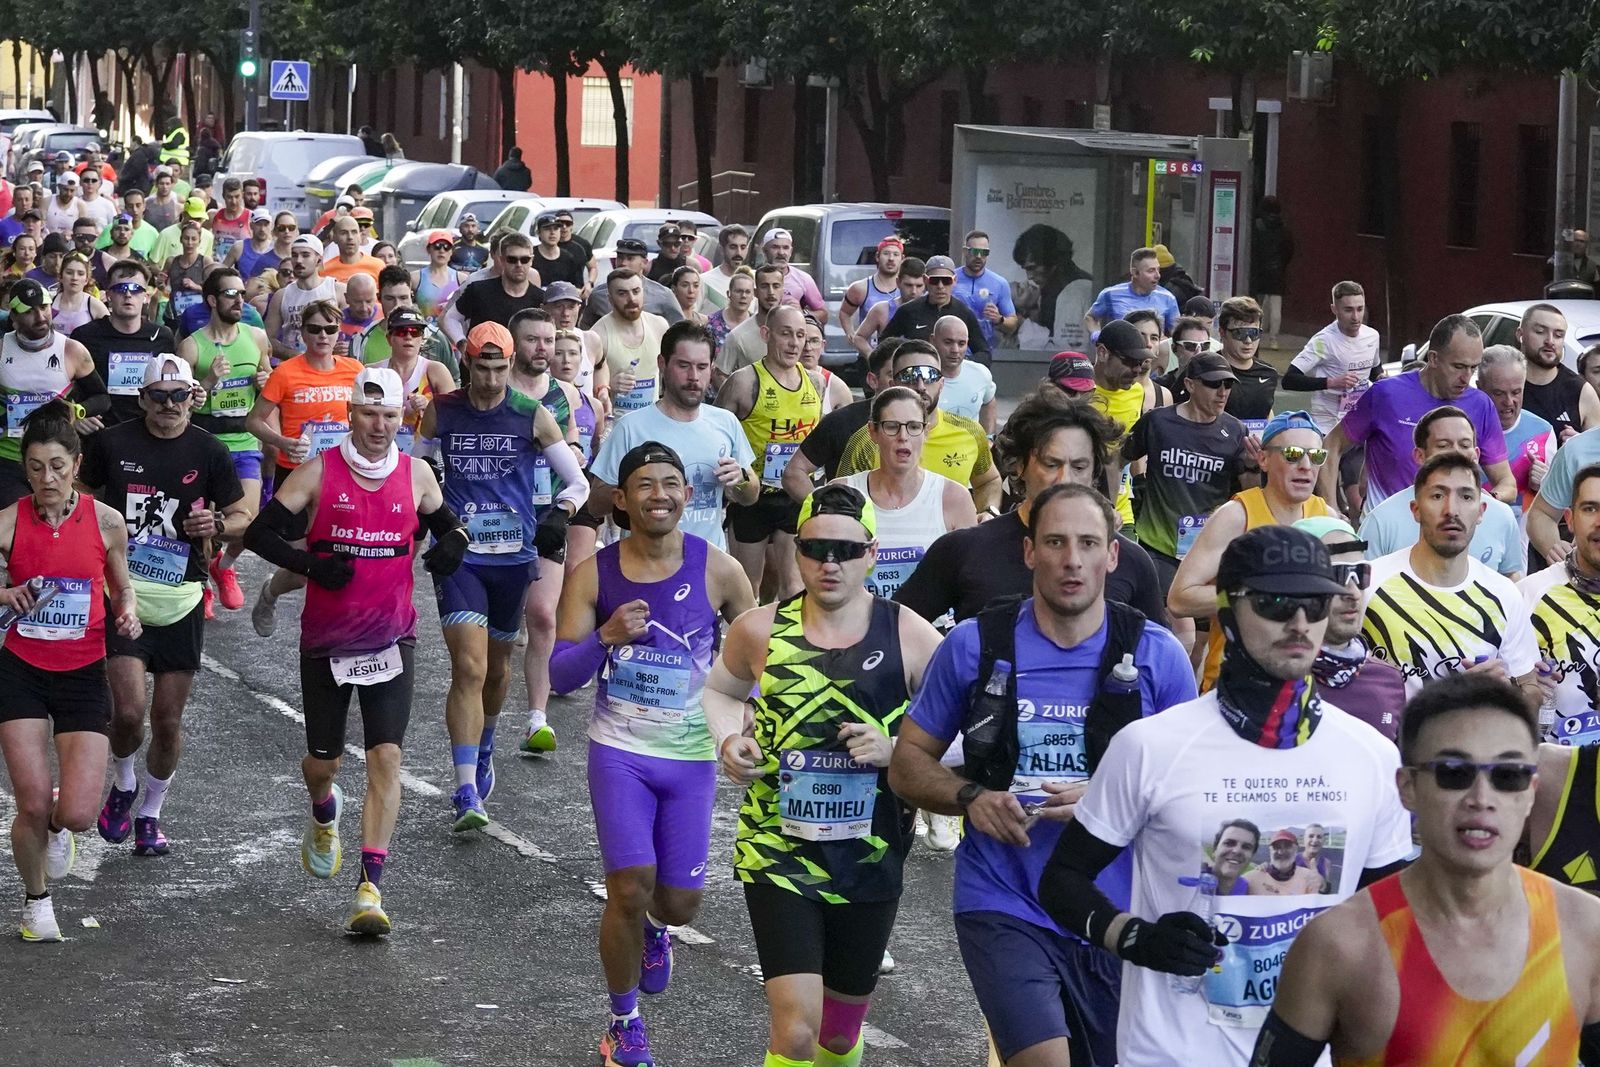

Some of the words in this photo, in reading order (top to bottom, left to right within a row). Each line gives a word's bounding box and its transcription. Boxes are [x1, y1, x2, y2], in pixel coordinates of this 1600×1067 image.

[1155, 163, 1167, 172] C2
[1170, 163, 1177, 172] 5
[1182, 163, 1188, 172] 6
[1191, 163, 1202, 172] 43
[121, 376, 143, 385] JACK
[225, 379, 248, 388] ZURICH
[319, 424, 345, 432] ZURICH
[127, 483, 156, 495] SEVILLA
[151, 538, 183, 553] ZURICH
[350, 546, 359, 555] DE
[876, 550, 916, 561] ZURICH
[877, 570, 900, 580] 6633
[637, 650, 682, 666] ZURICH
[346, 661, 389, 677] JESULI
[635, 671, 660, 685] 9688
[616, 678, 634, 689] SETIA
[635, 683, 655, 694] ASICS
[656, 687, 679, 697] FRON-
[629, 693, 661, 706] TRUNNER
[1044, 733, 1076, 746] 6855
[1029, 752, 1088, 773] ALIAS
[812, 783, 842, 795] 6890
[1222, 778, 1237, 789] TE
[1244, 778, 1289, 790] QUIERO
[1296, 775, 1331, 788] PAPÁ.
[1203, 792, 1218, 803] TE
[1226, 792, 1278, 803] ECHAMOS
[1285, 792, 1299, 802] DE
[1307, 791, 1348, 802] MENOS!
[787, 798, 865, 819] MATHIEU
[1249, 911, 1315, 940] ZURICH
